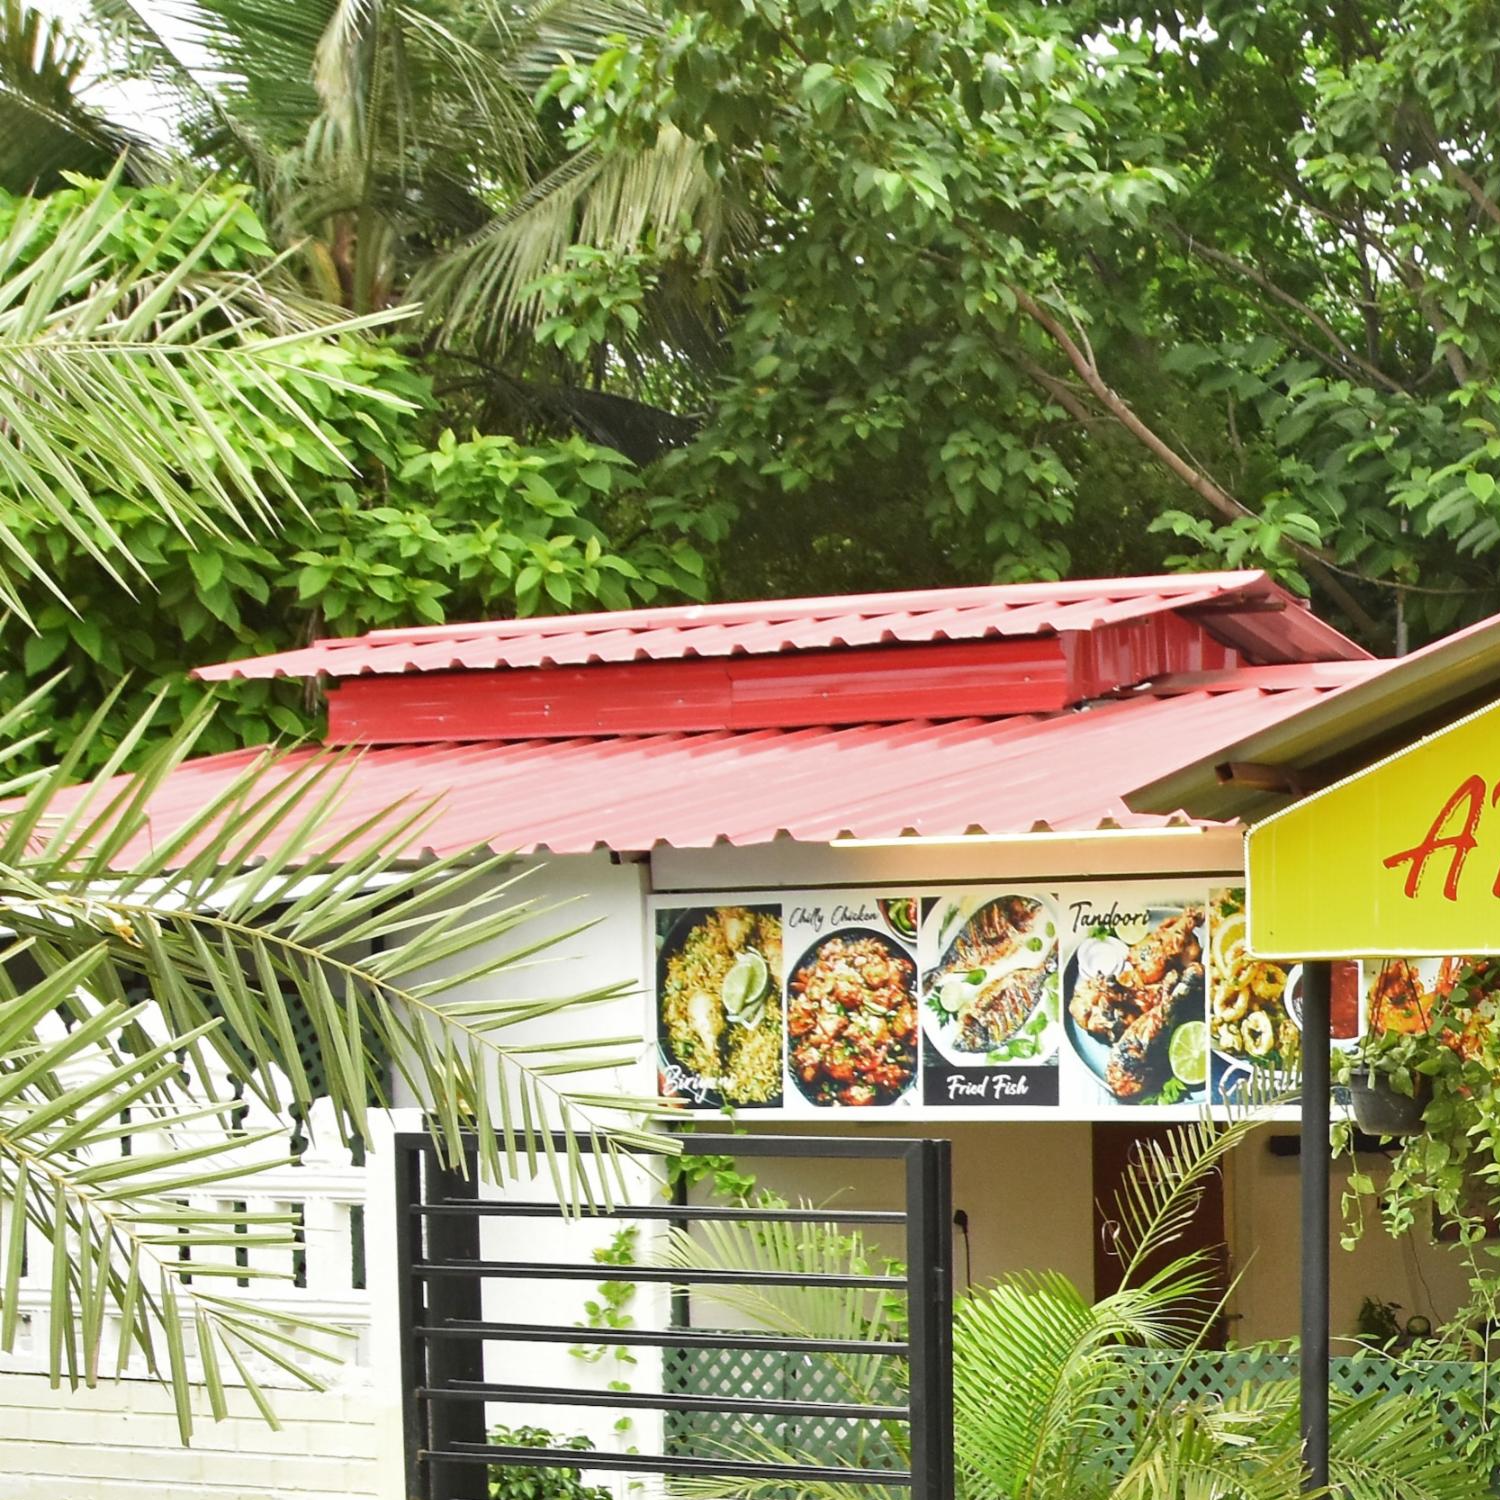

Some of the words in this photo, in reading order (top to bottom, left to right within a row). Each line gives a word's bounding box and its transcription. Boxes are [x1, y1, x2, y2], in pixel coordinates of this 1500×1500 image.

[789, 907, 824, 932] Chilly
[831, 904, 877, 926] Chicken
[1069, 901, 1151, 933] Tandoori
[946, 1074, 989, 1100] Fried
[992, 1074, 1029, 1100] Fish
